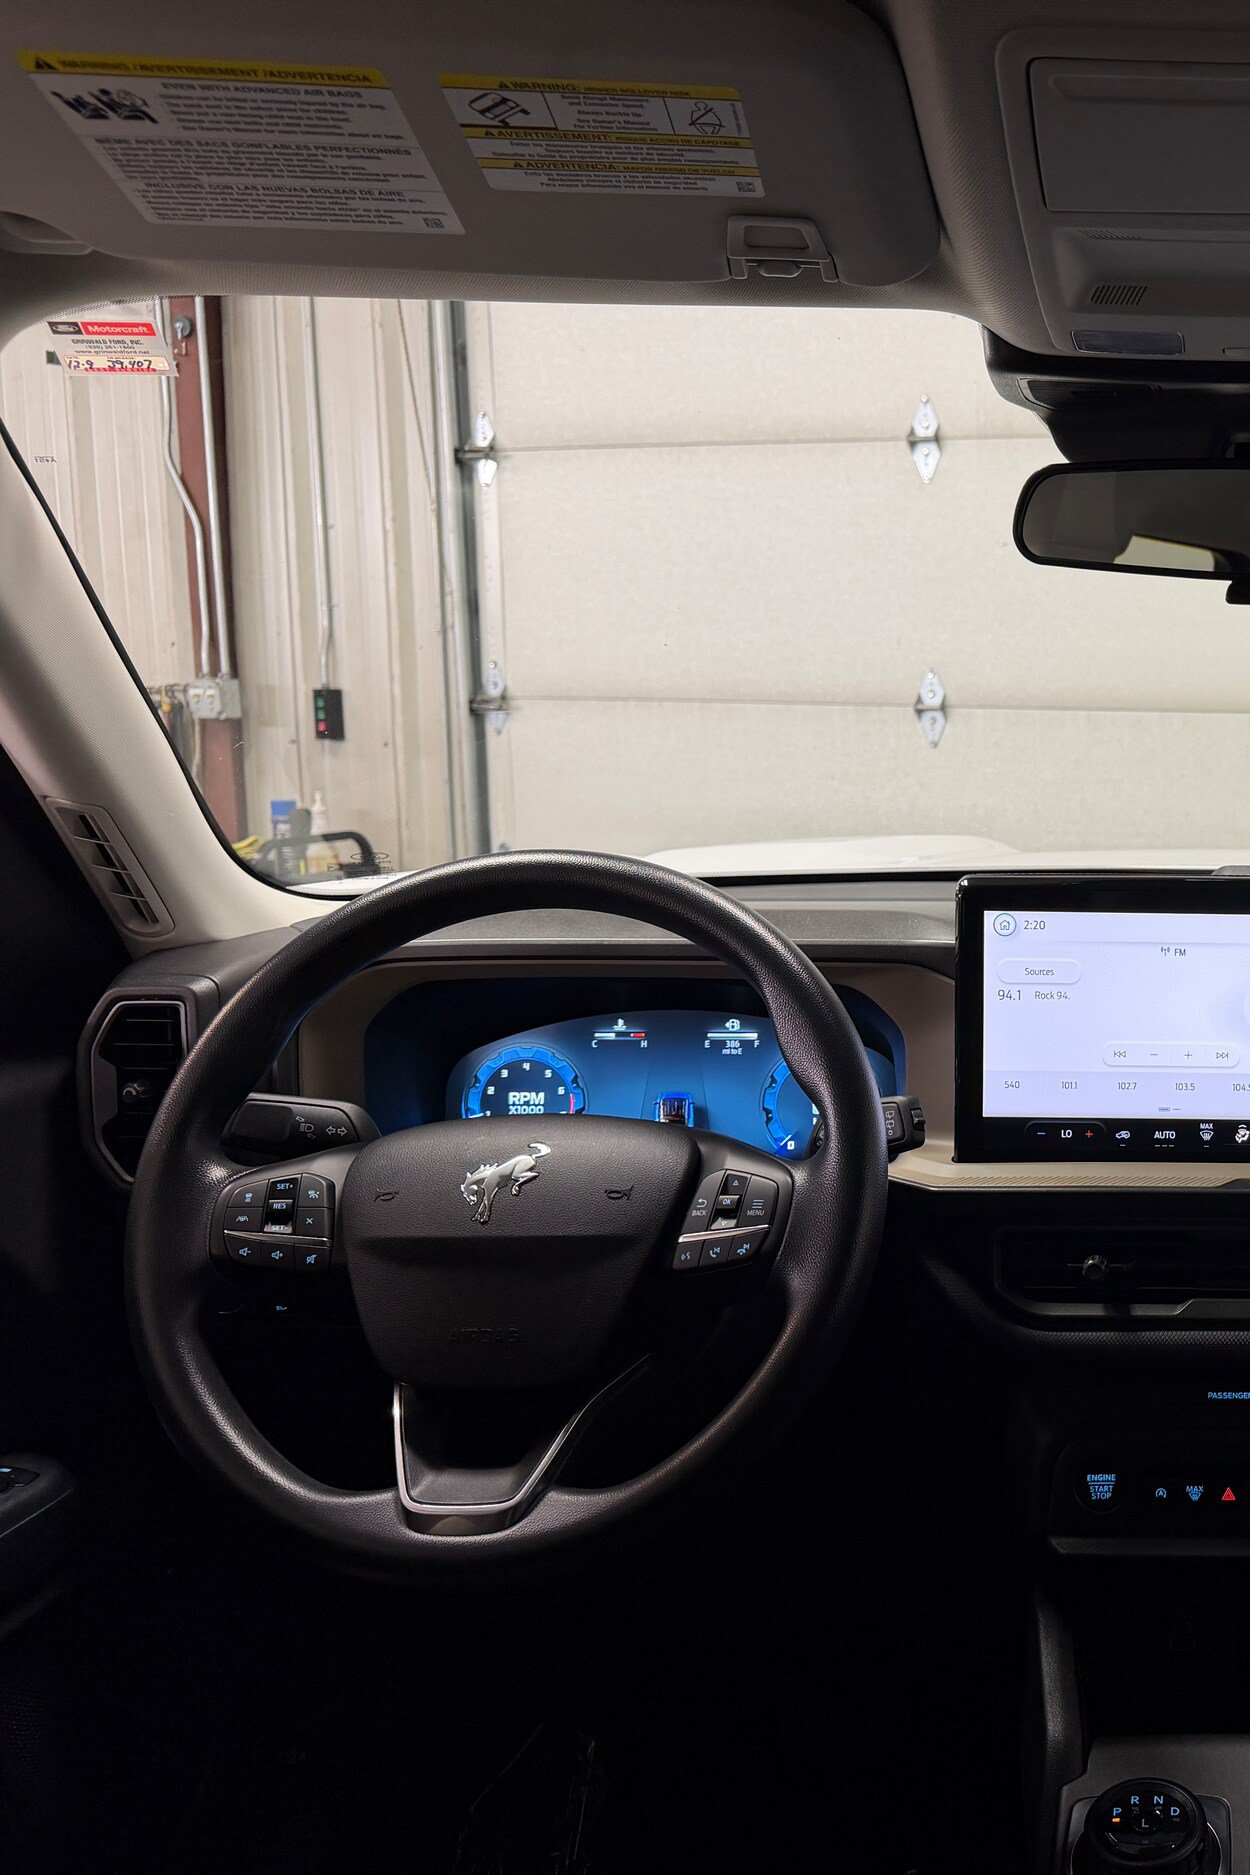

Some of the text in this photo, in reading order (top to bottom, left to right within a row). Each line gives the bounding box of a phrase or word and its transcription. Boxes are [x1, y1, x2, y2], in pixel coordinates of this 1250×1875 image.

[87, 324, 150, 334] Motorcraft
[1023, 920, 1046, 931] 2:20
[1174, 948, 1187, 957] FM
[1024, 967, 1055, 977] Sources
[997, 989, 1022, 1001] 94.1
[1034, 991, 1056, 1000] Rock
[591, 1040, 598, 1048] C
[640, 1040, 648, 1048] H
[704, 1040, 711, 1048] E
[725, 1040, 740, 1048] 386
[754, 1040, 760, 1048] F
[523, 1062, 530, 1071] 4
[501, 1069, 509, 1078] 3
[544, 1069, 552, 1078] 5
[1004, 1080, 1021, 1089] 540
[1061, 1081, 1078, 1090] 101.1
[1117, 1082, 1137, 1091] 102.7
[1174, 1082, 1196, 1091] 103.5
[487, 1086, 495, 1095] 2
[557, 1086, 565, 1095] 6
[508, 1091, 545, 1105] RPM
[508, 1105, 545, 1115] X1000
[1199, 1122, 1213, 1130] MAX
[1060, 1129, 1073, 1139] LO
[1153, 1130, 1176, 1139] AUTO
[1086, 1473, 1117, 1482] ENGINE
[1186, 1485, 1204, 1493] MAX
[1091, 1492, 1112, 1500] STOP
[1130, 1795, 1140, 1805] R
[1154, 1795, 1164, 1805] N
[1112, 1807, 1122, 1816] P
[1170, 1807, 1180, 1816] D
[1141, 1819, 1149, 1828] L
